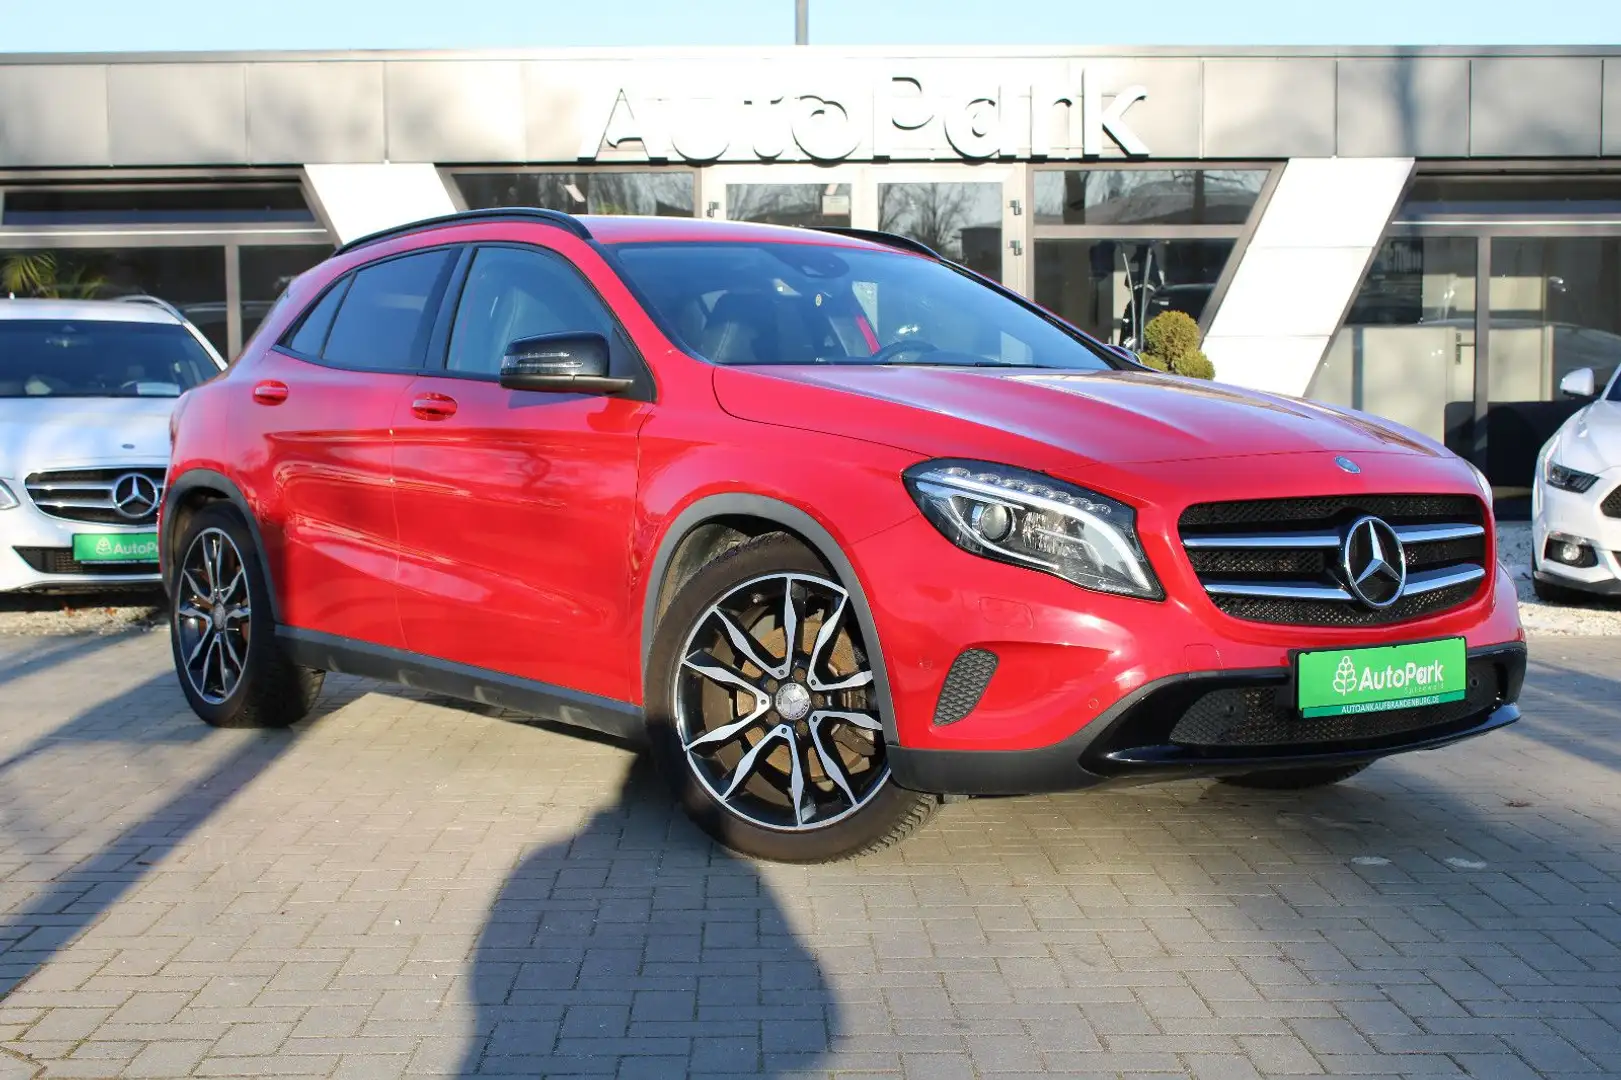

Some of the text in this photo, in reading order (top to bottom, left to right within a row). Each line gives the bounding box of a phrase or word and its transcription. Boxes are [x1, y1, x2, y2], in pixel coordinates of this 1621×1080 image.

[577, 66, 1150, 167] AutoPark
[1358, 659, 1444, 692] AutoPark
[1341, 695, 1440, 714] AUTOANKAUFBRANDENBURG.DE
